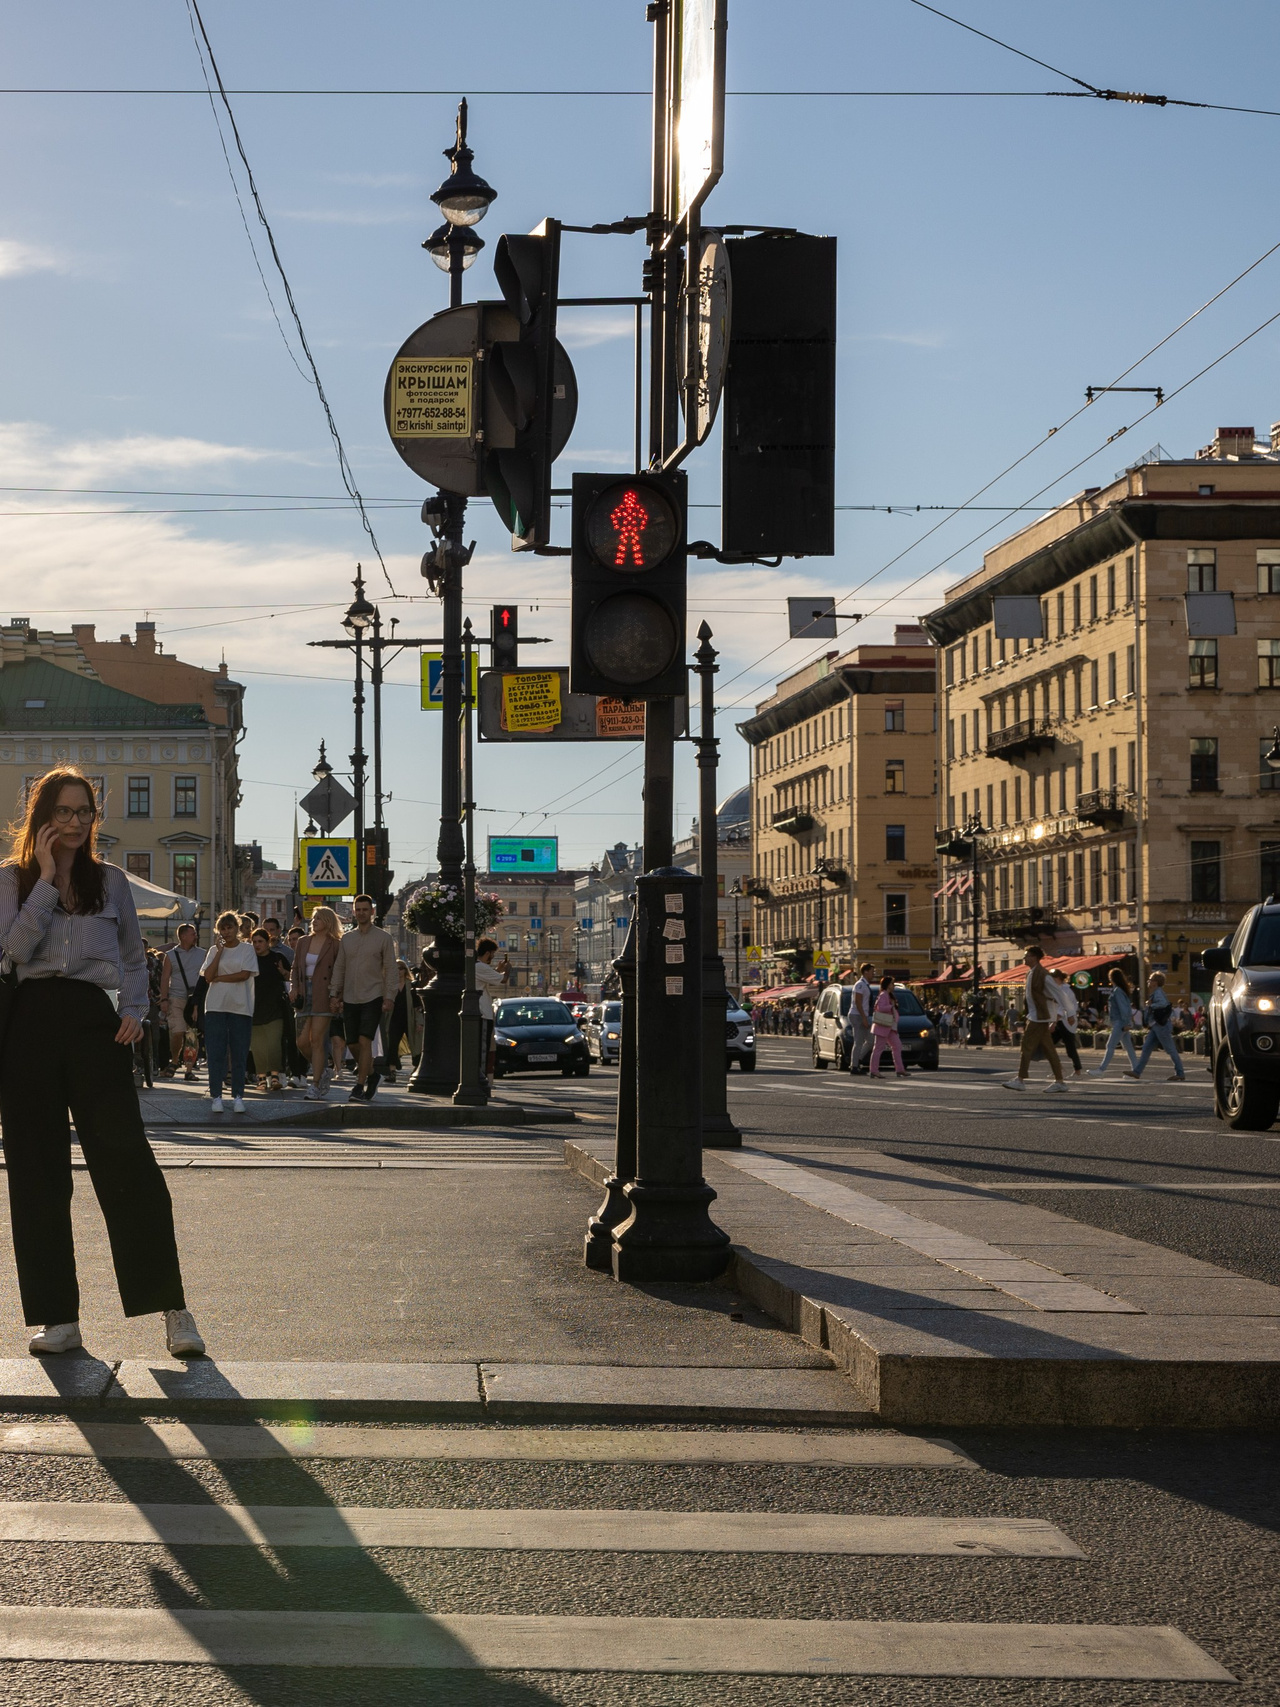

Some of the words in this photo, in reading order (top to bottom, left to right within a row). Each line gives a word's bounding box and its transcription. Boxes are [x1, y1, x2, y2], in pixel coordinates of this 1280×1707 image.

[398, 364, 453, 373] ЭКСКУРСИИ
[454, 364, 468, 373] ПО
[398, 377, 467, 389] КРЫШАМ
[396, 407, 466, 419] +7977-652-88-54
[409, 420, 466, 432] krishi_saintpi
[515, 674, 552, 683] ТОПОВЫЕ
[508, 683, 548, 692] ЭКСКУРСИИ
